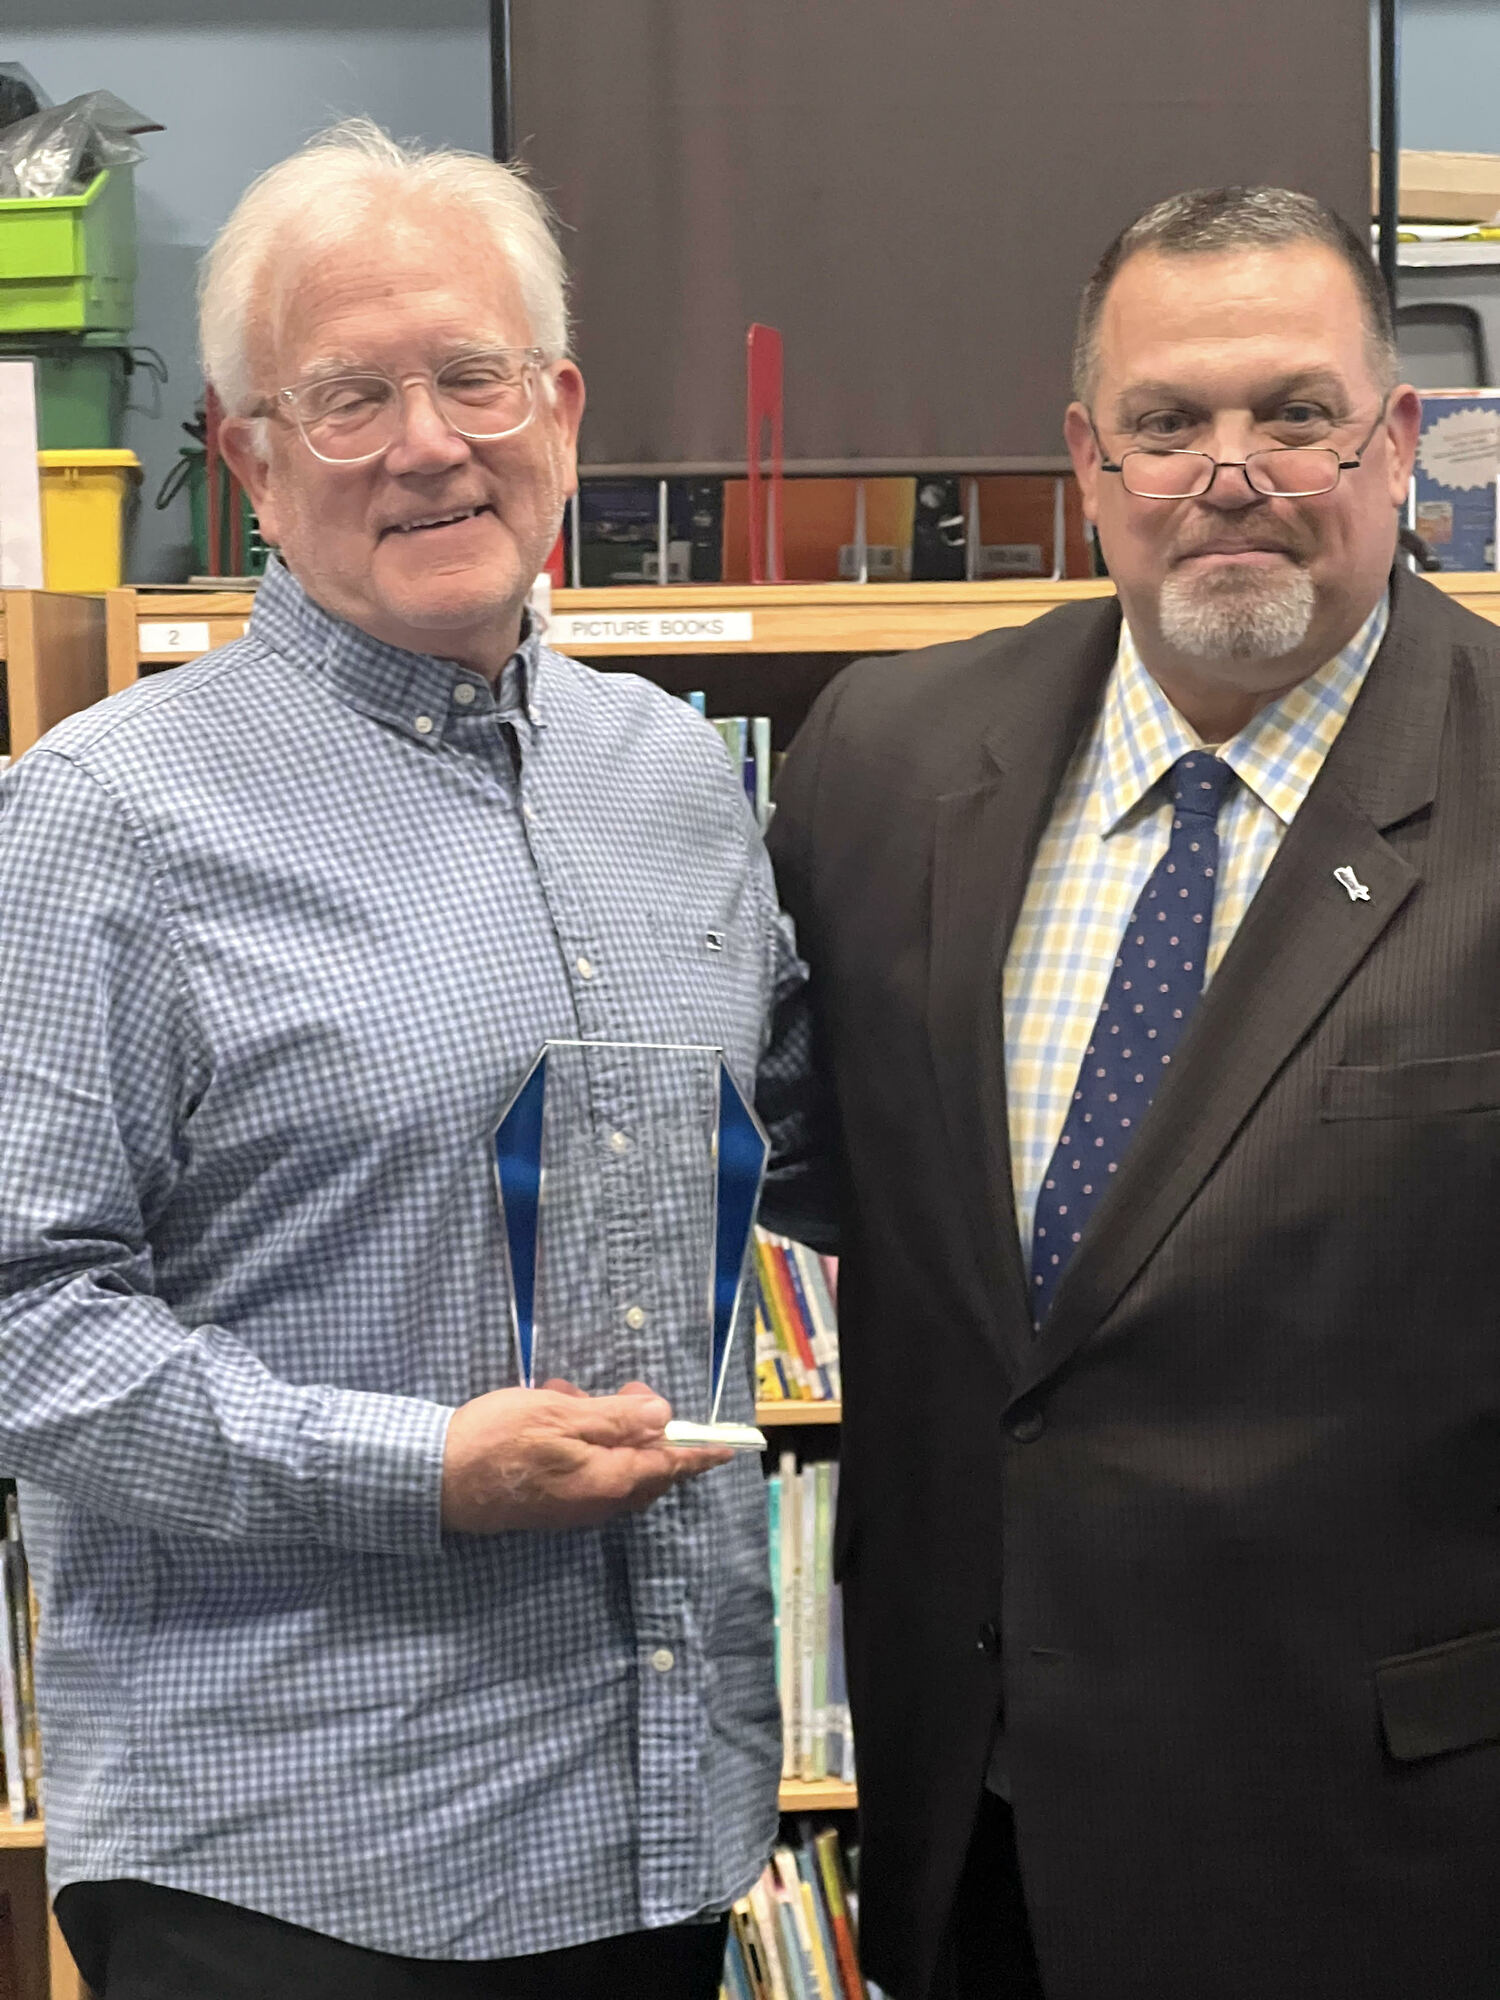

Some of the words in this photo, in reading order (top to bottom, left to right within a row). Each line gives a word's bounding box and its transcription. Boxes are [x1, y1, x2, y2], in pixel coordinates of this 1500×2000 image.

[572, 621, 649, 636] PICTURE
[660, 619, 724, 635] BOOKS
[168, 630, 180, 645] 2
